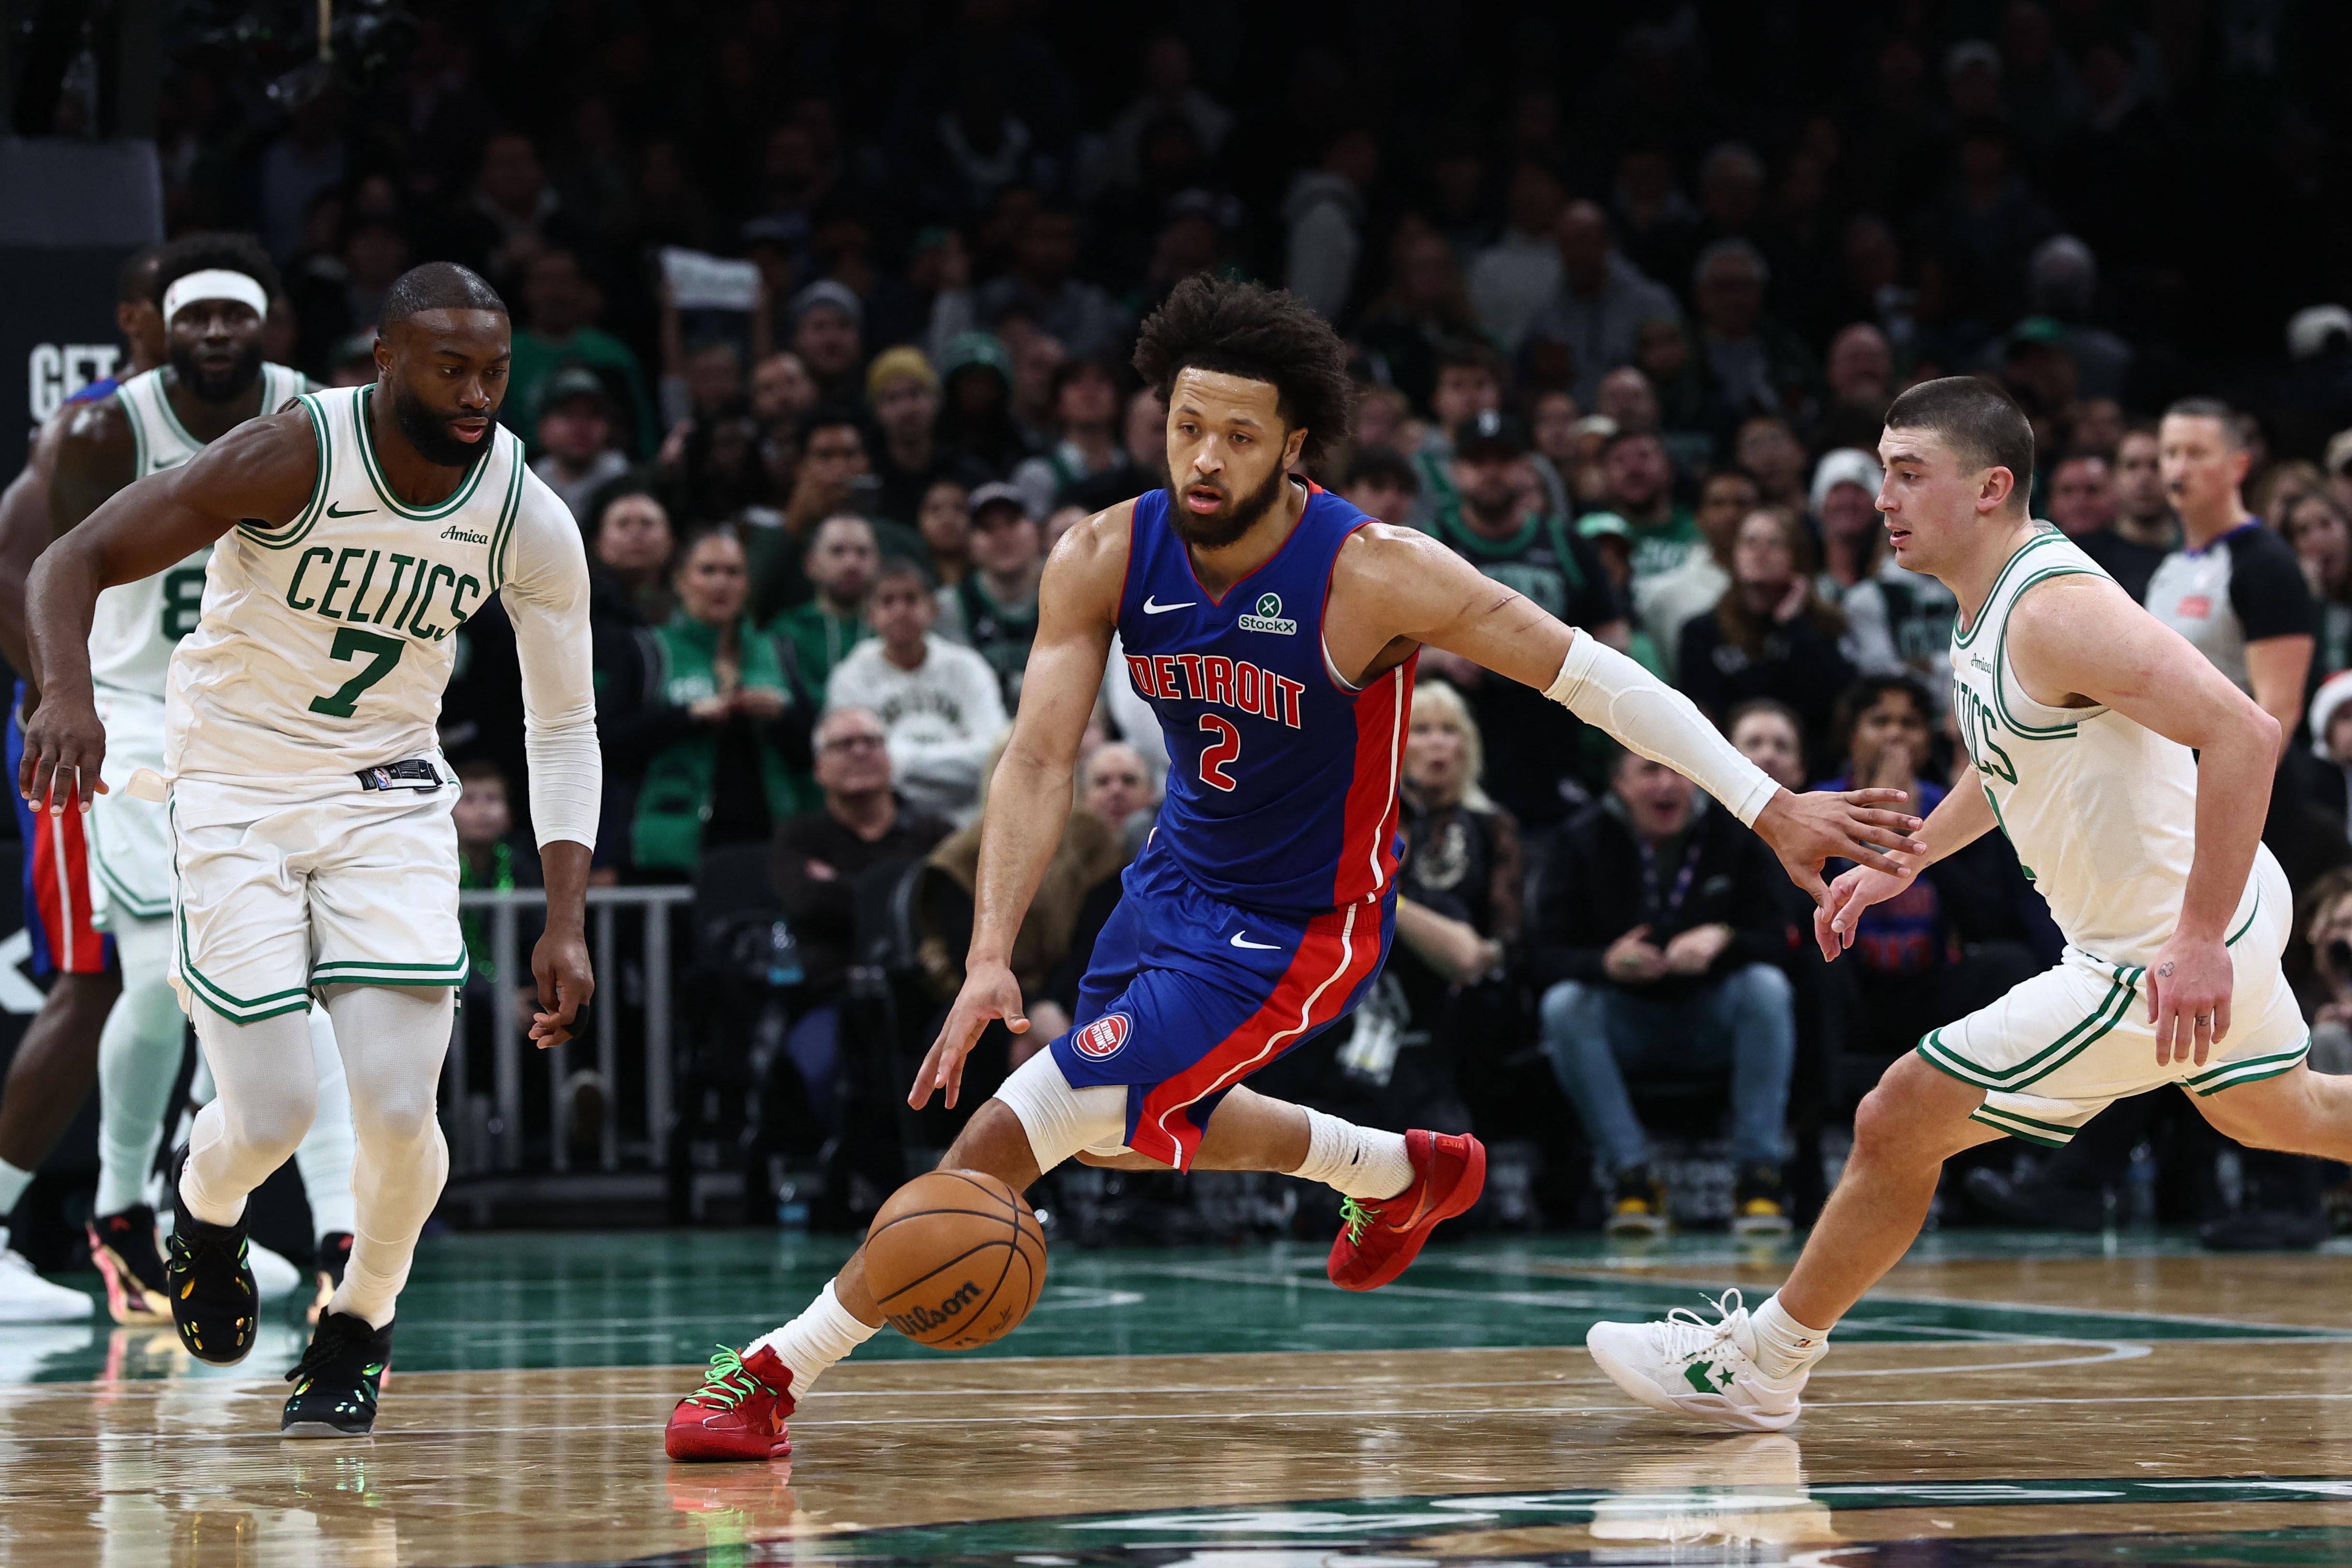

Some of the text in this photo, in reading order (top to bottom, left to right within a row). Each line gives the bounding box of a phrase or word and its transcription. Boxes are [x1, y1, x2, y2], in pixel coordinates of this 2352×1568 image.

[440, 526, 488, 544] Amica
[286, 547, 481, 642] CELTICS
[1241, 616, 1294, 633] StockX
[308, 627, 407, 718] 7
[1971, 653, 1991, 674] Amica
[1124, 653, 1306, 730] DETROIT
[1198, 713, 1241, 792] 2
[1090, 1024, 1108, 1051] PISTONS
[1099, 1020, 1117, 1045] DETROIT
[1442, 1140, 1464, 1150] NIKE
